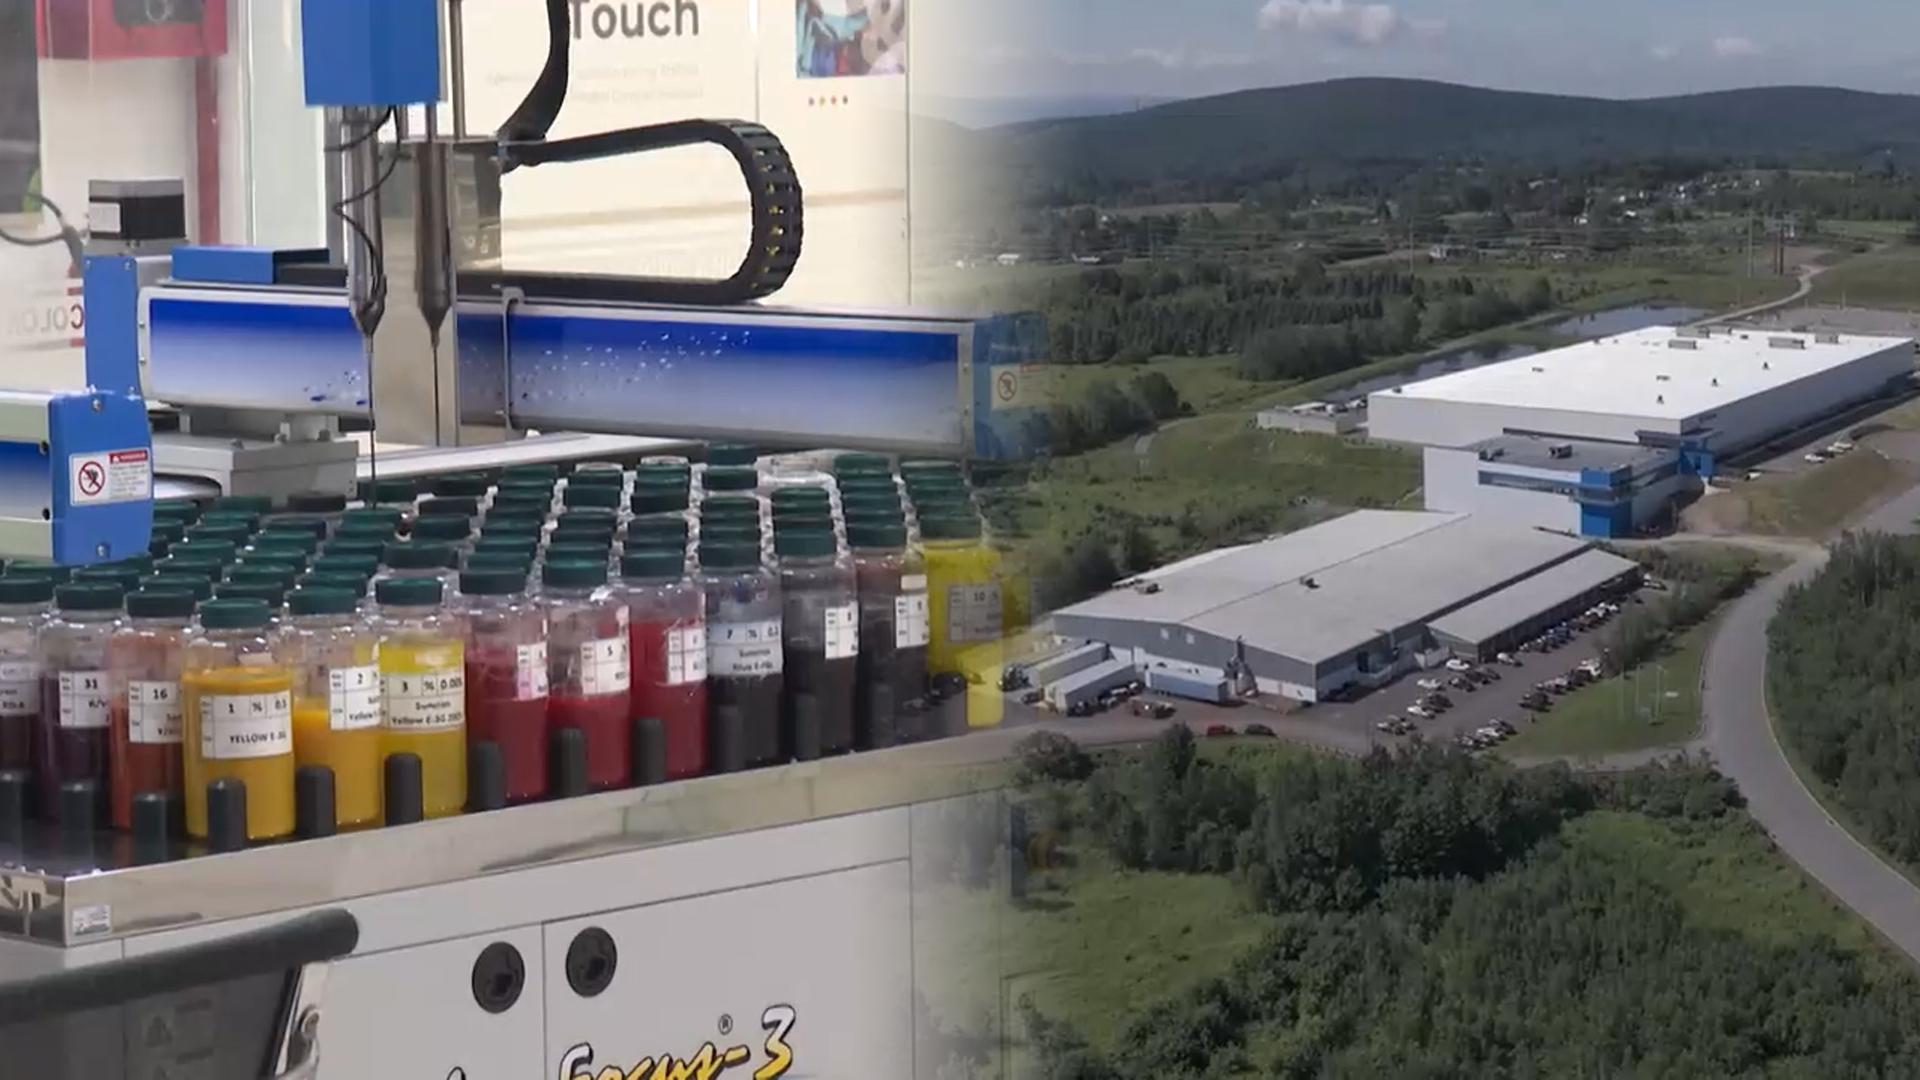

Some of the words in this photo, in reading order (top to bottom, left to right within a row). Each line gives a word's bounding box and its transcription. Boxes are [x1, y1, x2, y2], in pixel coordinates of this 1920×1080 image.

[570, 0, 699, 39] Touch
[153, 689, 168, 700] 16
[228, 703, 235, 714] 1
[229, 734, 268, 744] YELLOW
